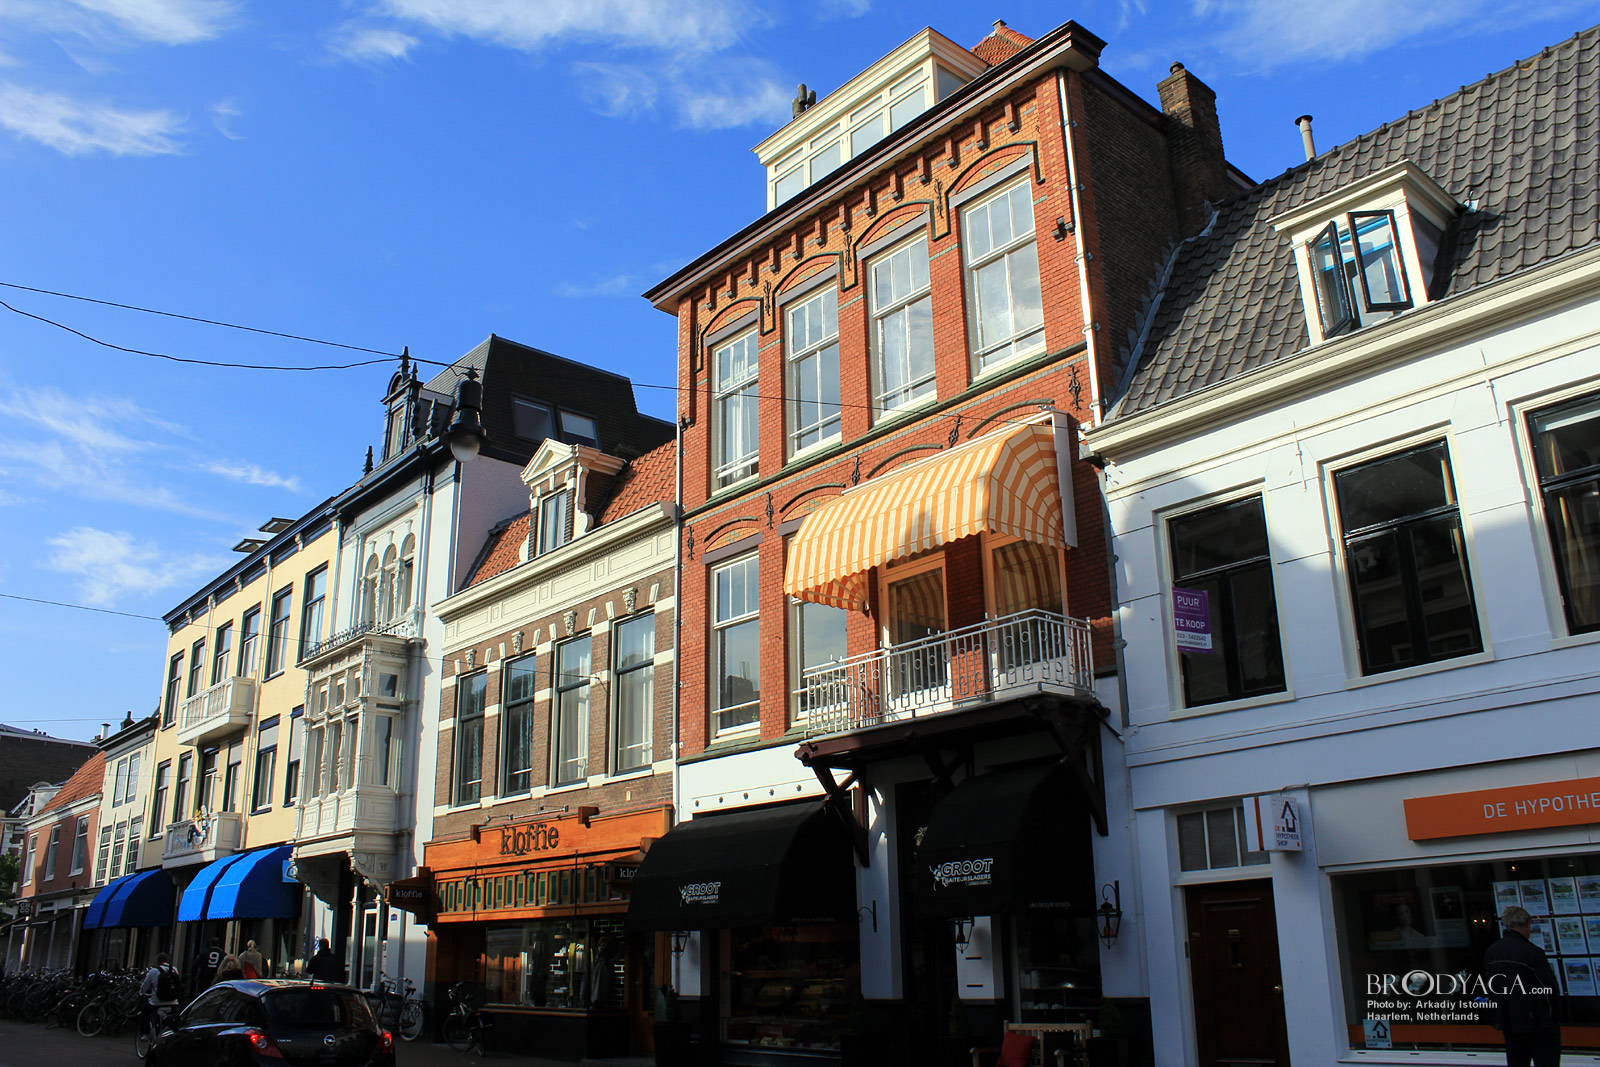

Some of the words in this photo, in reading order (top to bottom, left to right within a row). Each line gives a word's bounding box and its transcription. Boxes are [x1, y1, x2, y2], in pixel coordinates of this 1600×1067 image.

[1177, 595, 1200, 607] PUUR
[1175, 618, 1184, 627] TE
[1186, 619, 1206, 629] KOOP
[1483, 802, 1507, 819] DE
[1514, 792, 1600, 816] HYPOTHE
[499, 822, 560, 856] kloffie
[941, 858, 994, 877] GROOT
[395, 889, 423, 898] kloffie
[687, 881, 722, 896] GROOT
[207, 951, 220, 964] 9
